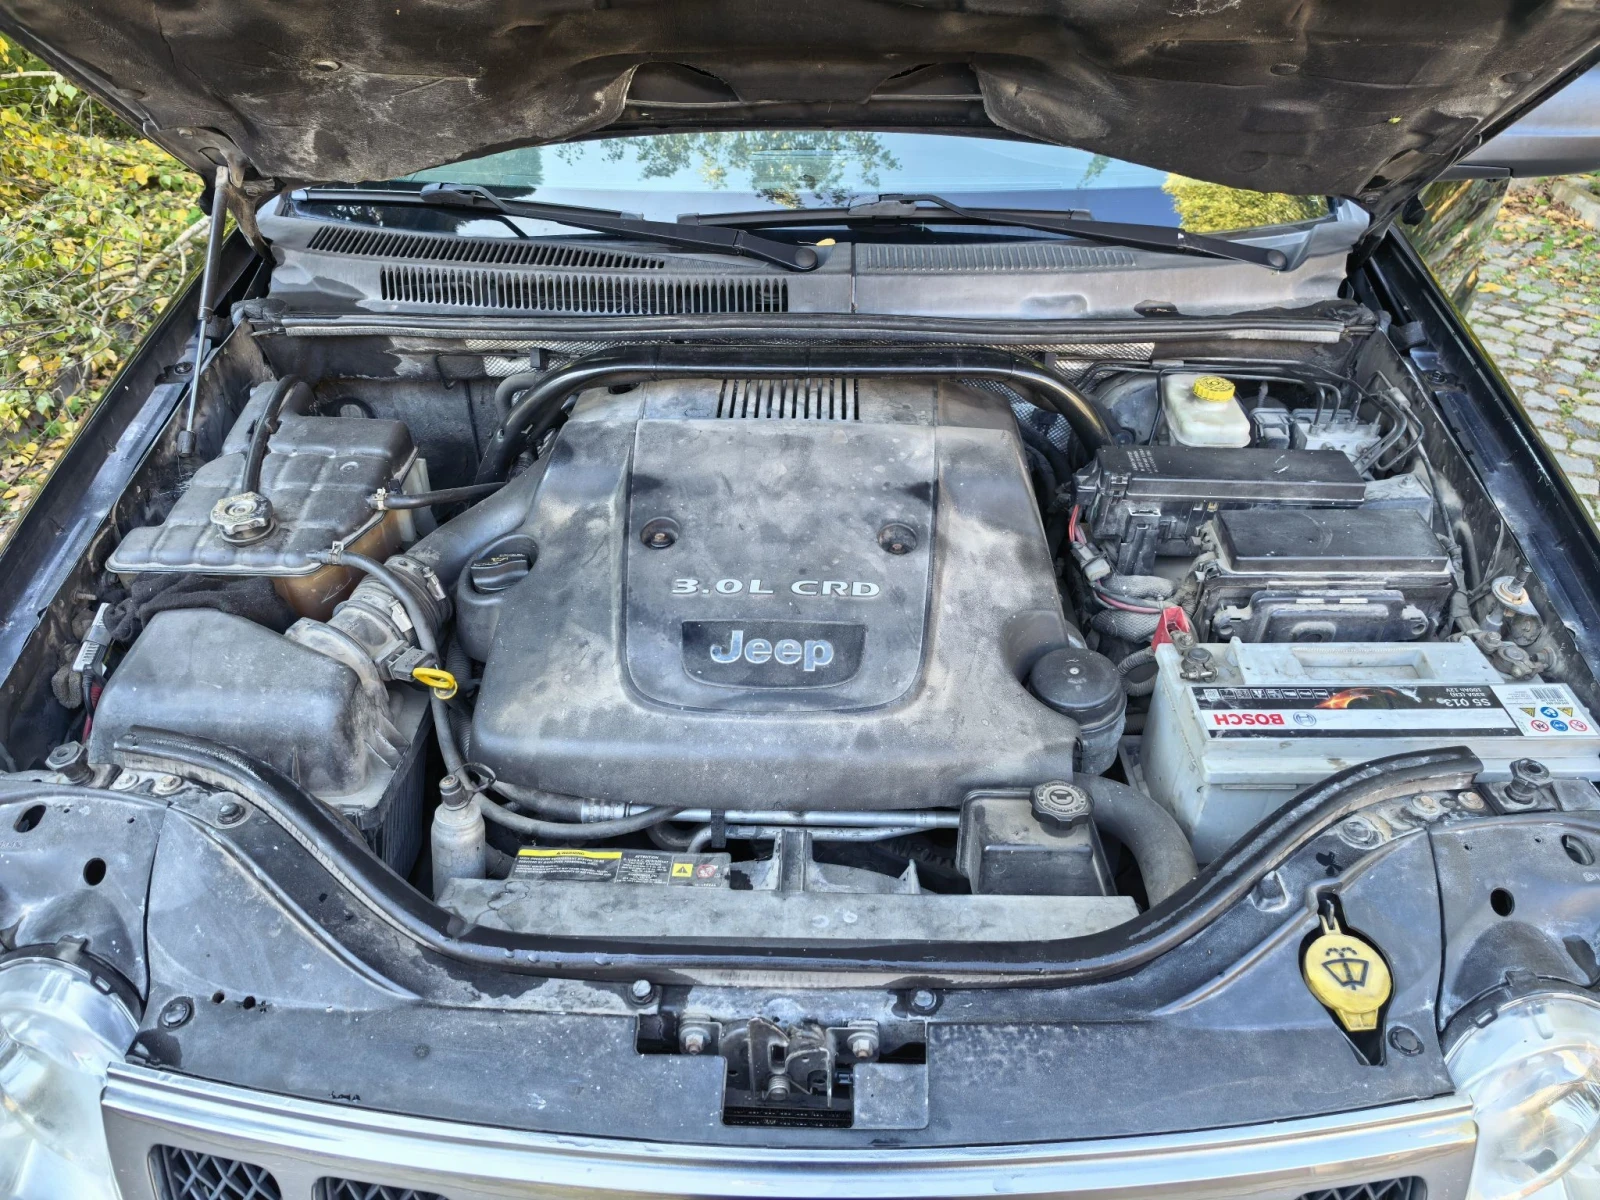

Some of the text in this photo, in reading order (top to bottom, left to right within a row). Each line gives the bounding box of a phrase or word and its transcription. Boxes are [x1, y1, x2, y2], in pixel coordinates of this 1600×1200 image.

[672, 578, 880, 597] 3.0L CRD
[710, 630, 834, 672] Jeep
[1443, 698, 1491, 706] S5 013
[1213, 713, 1285, 726] BOSCH
